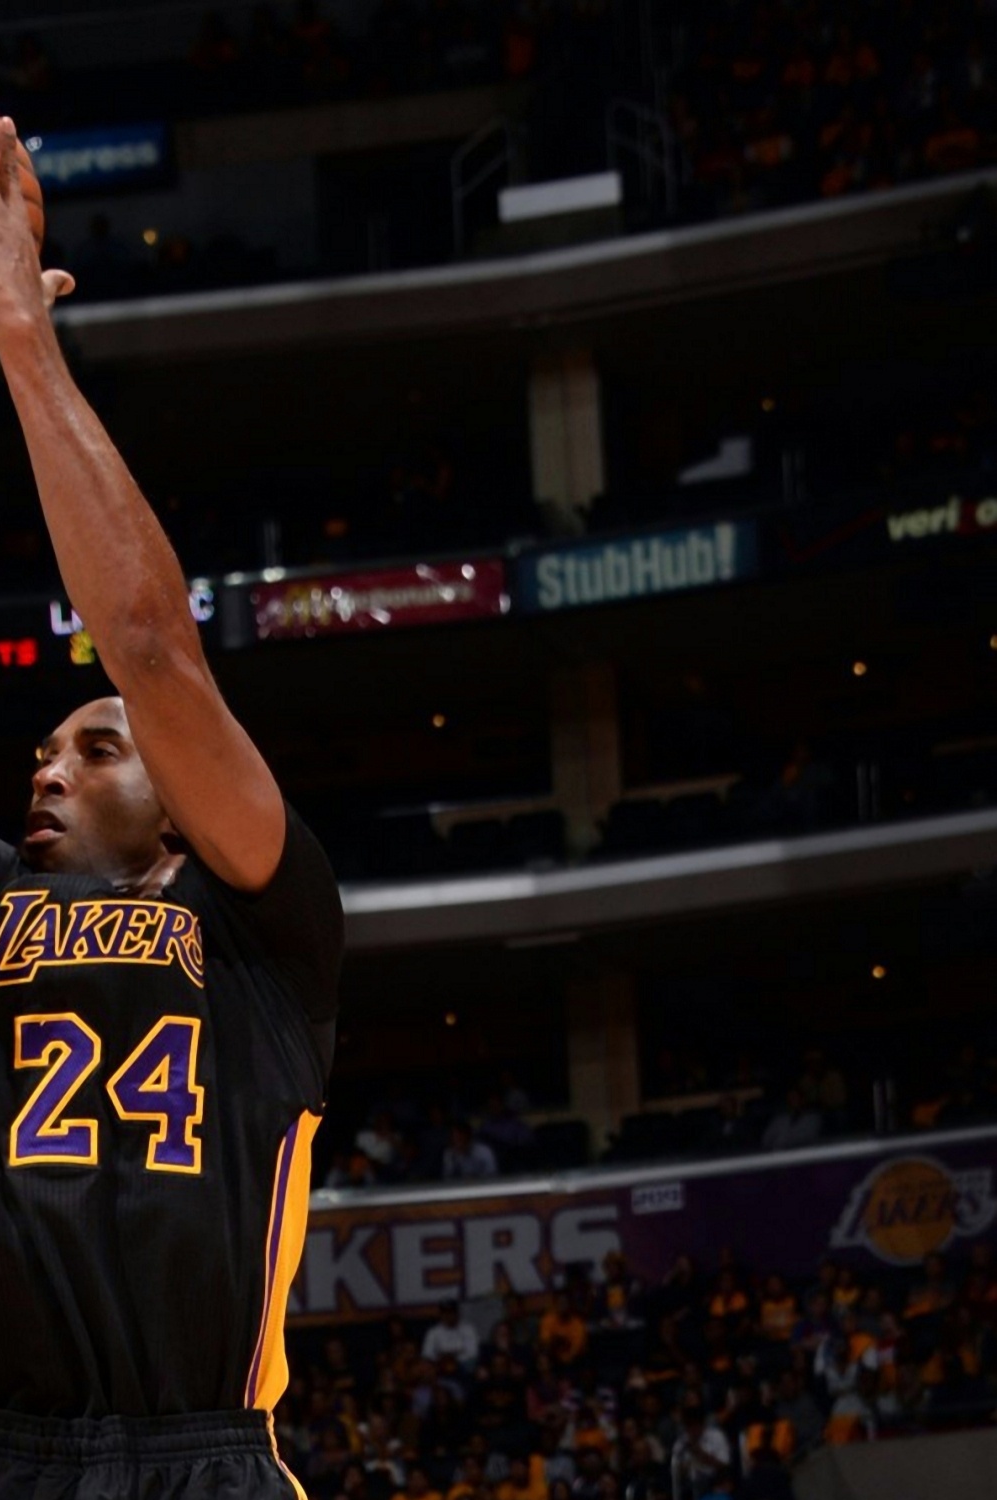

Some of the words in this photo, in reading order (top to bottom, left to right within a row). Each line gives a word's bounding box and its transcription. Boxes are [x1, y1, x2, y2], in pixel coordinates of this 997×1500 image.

[536, 518, 739, 612] StubHub!
[9, 1012, 205, 1175] 24
[286, 1204, 626, 1312] KERS
